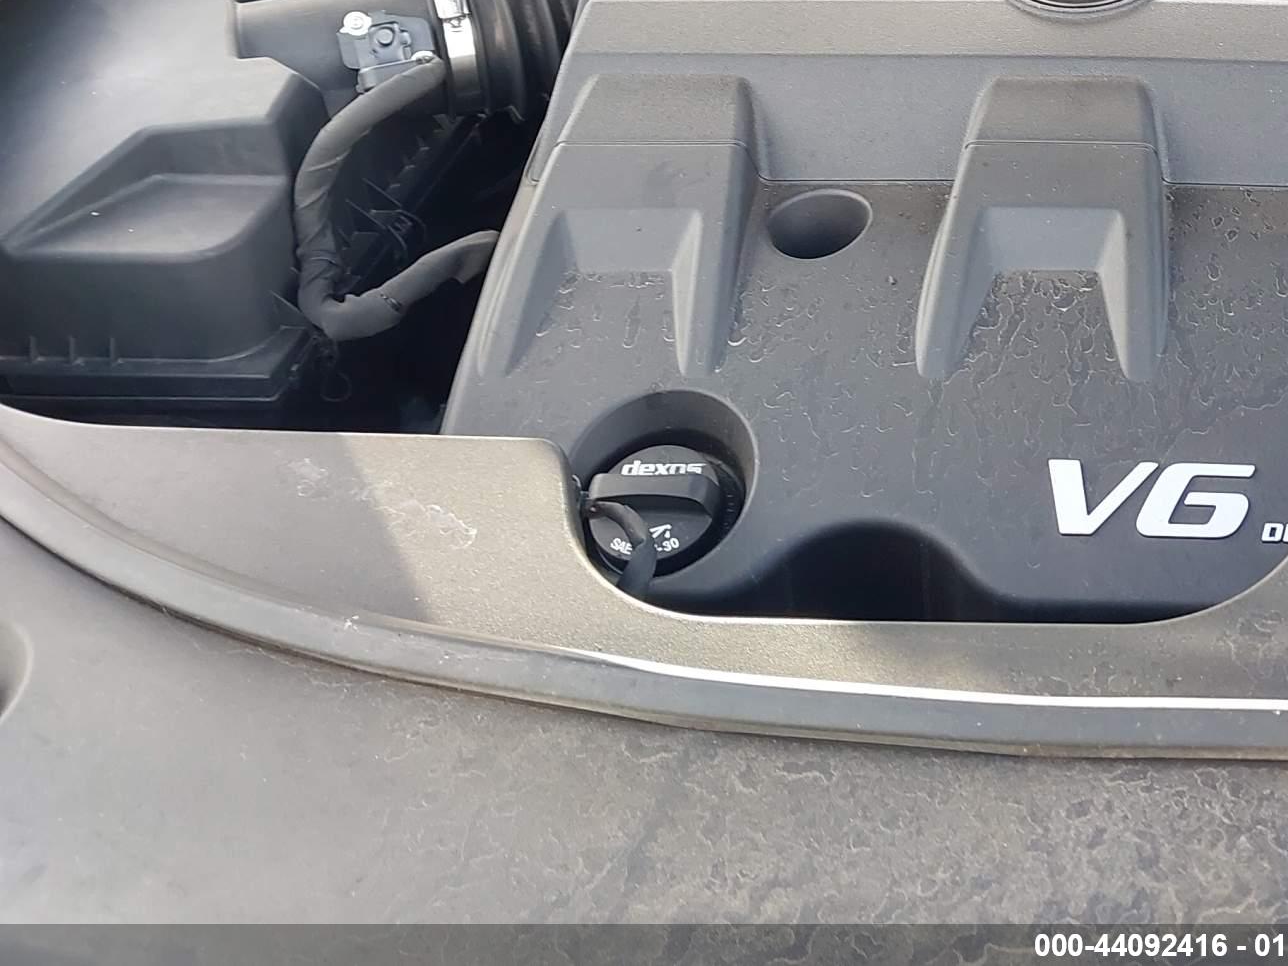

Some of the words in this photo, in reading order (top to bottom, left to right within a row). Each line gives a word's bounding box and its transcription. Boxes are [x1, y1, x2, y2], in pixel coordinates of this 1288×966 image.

[1048, 459, 1256, 538] V6
[610, 537, 633, 555] SAE
[654, 537, 680, 552] -30
